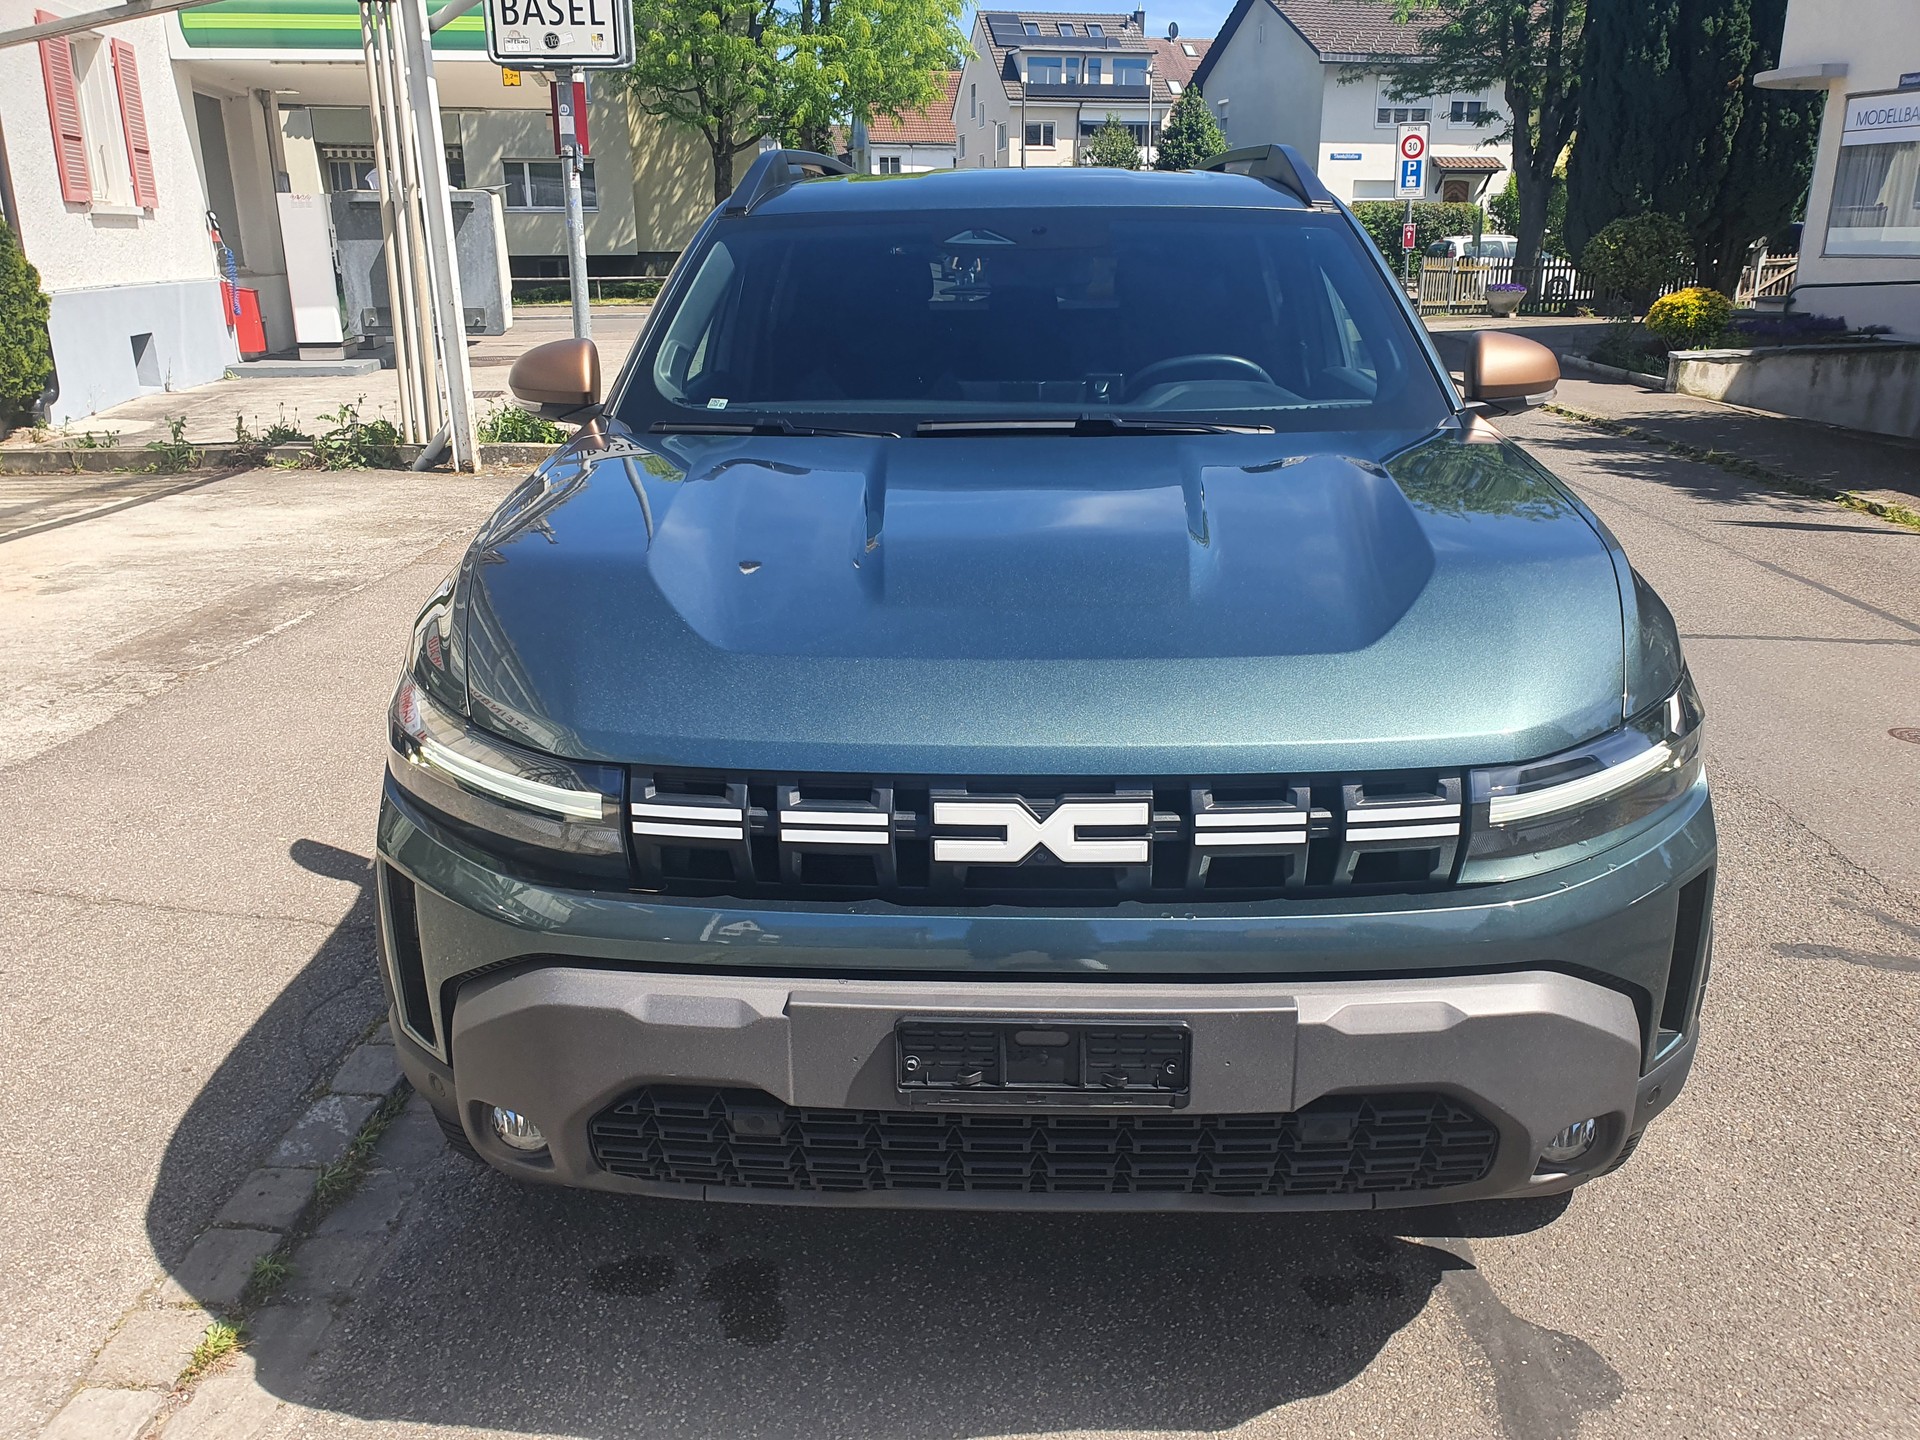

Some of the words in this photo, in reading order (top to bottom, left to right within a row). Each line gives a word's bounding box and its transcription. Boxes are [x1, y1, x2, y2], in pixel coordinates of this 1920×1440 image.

[501, 0, 605, 25] BASEL
[1407, 142, 1418, 151] 30
[1407, 162, 1417, 175] P
